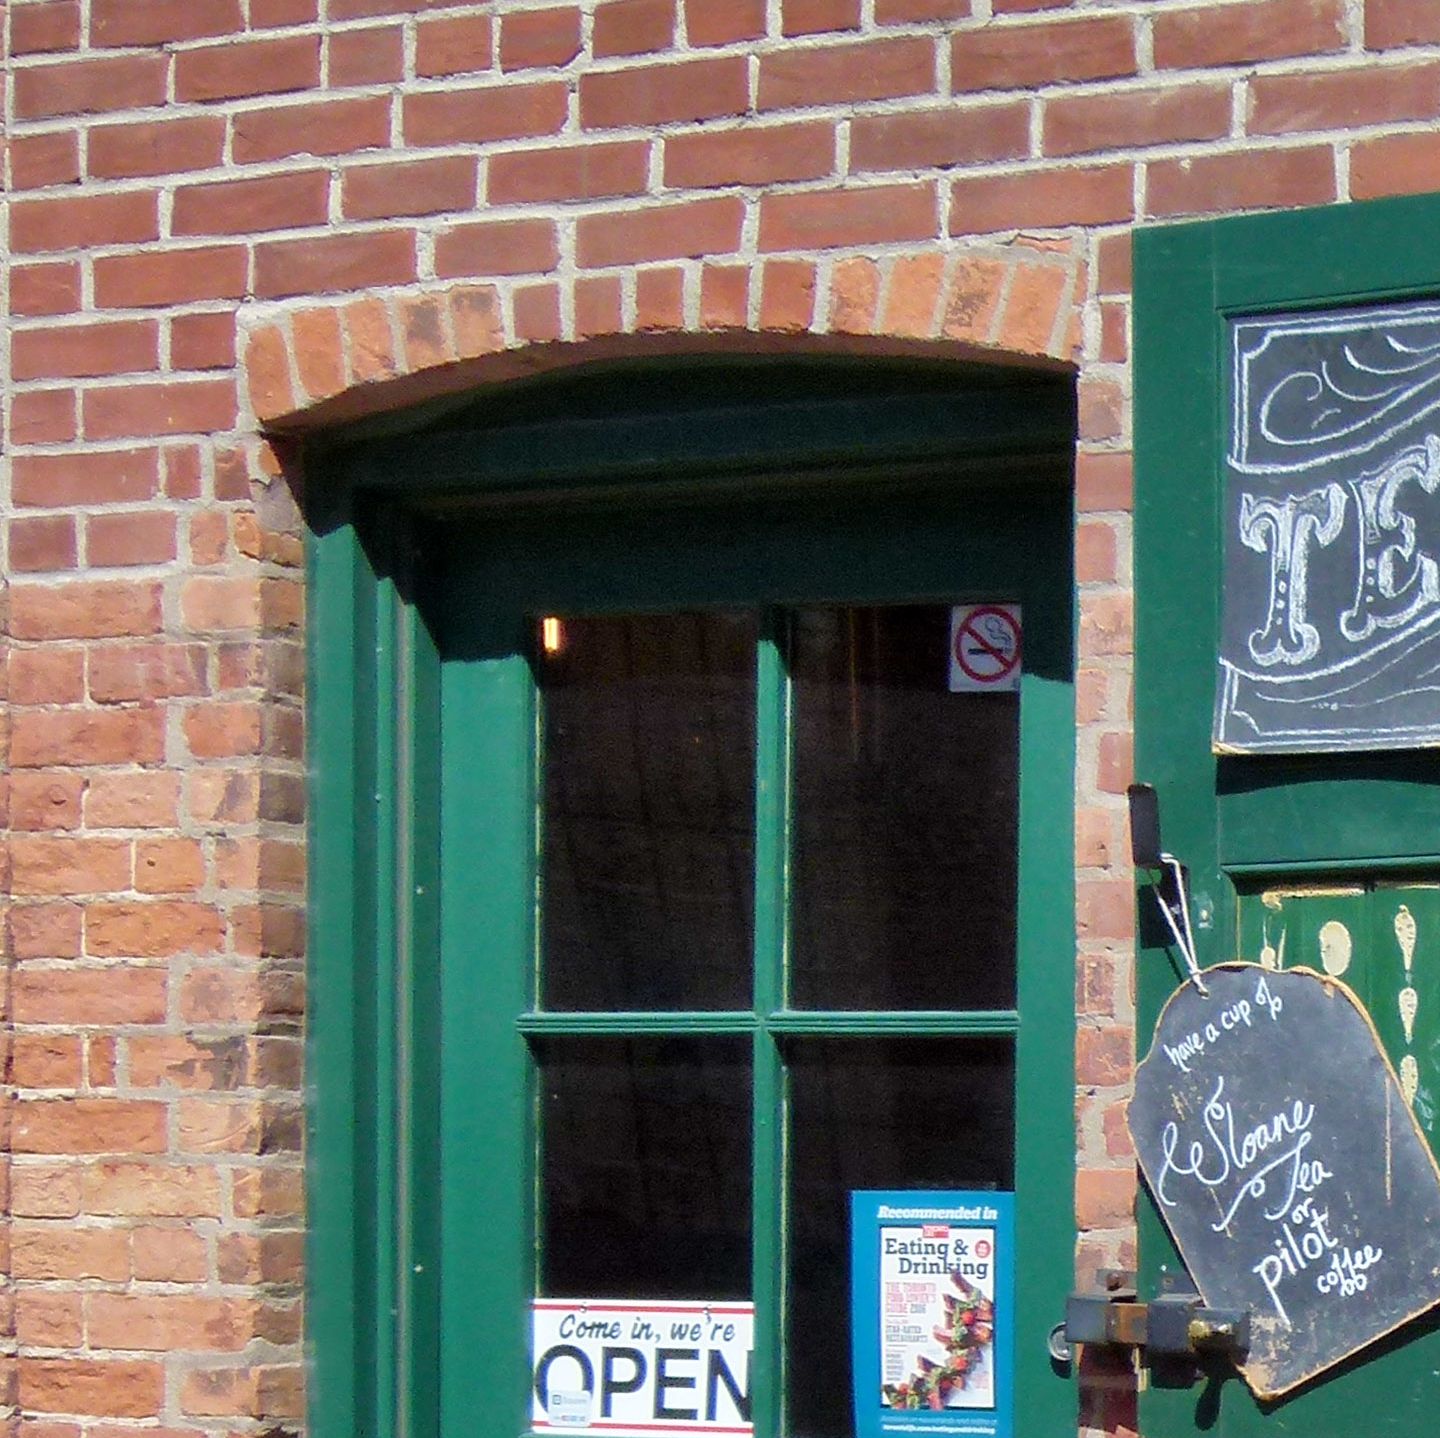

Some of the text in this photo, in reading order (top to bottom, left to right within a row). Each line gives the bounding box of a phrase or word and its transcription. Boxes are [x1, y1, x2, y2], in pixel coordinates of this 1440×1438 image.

[1163, 975, 1283, 1073] have a cup of
[1158, 1075, 1315, 1206] Sloane
[1211, 1131, 1334, 1232] Tea
[877, 1204, 998, 1220] Recommended in
[1291, 1197, 1315, 1225] or
[884, 1237, 950, 1261] Eating
[953, 1238, 969, 1256] &
[898, 1257, 989, 1280] Drinking
[1252, 1207, 1339, 1333] pilot
[1317, 1245, 1384, 1297] coffee
[559, 1311, 736, 1342] Come in, we're
[534, 1343, 754, 1423] OPEN
